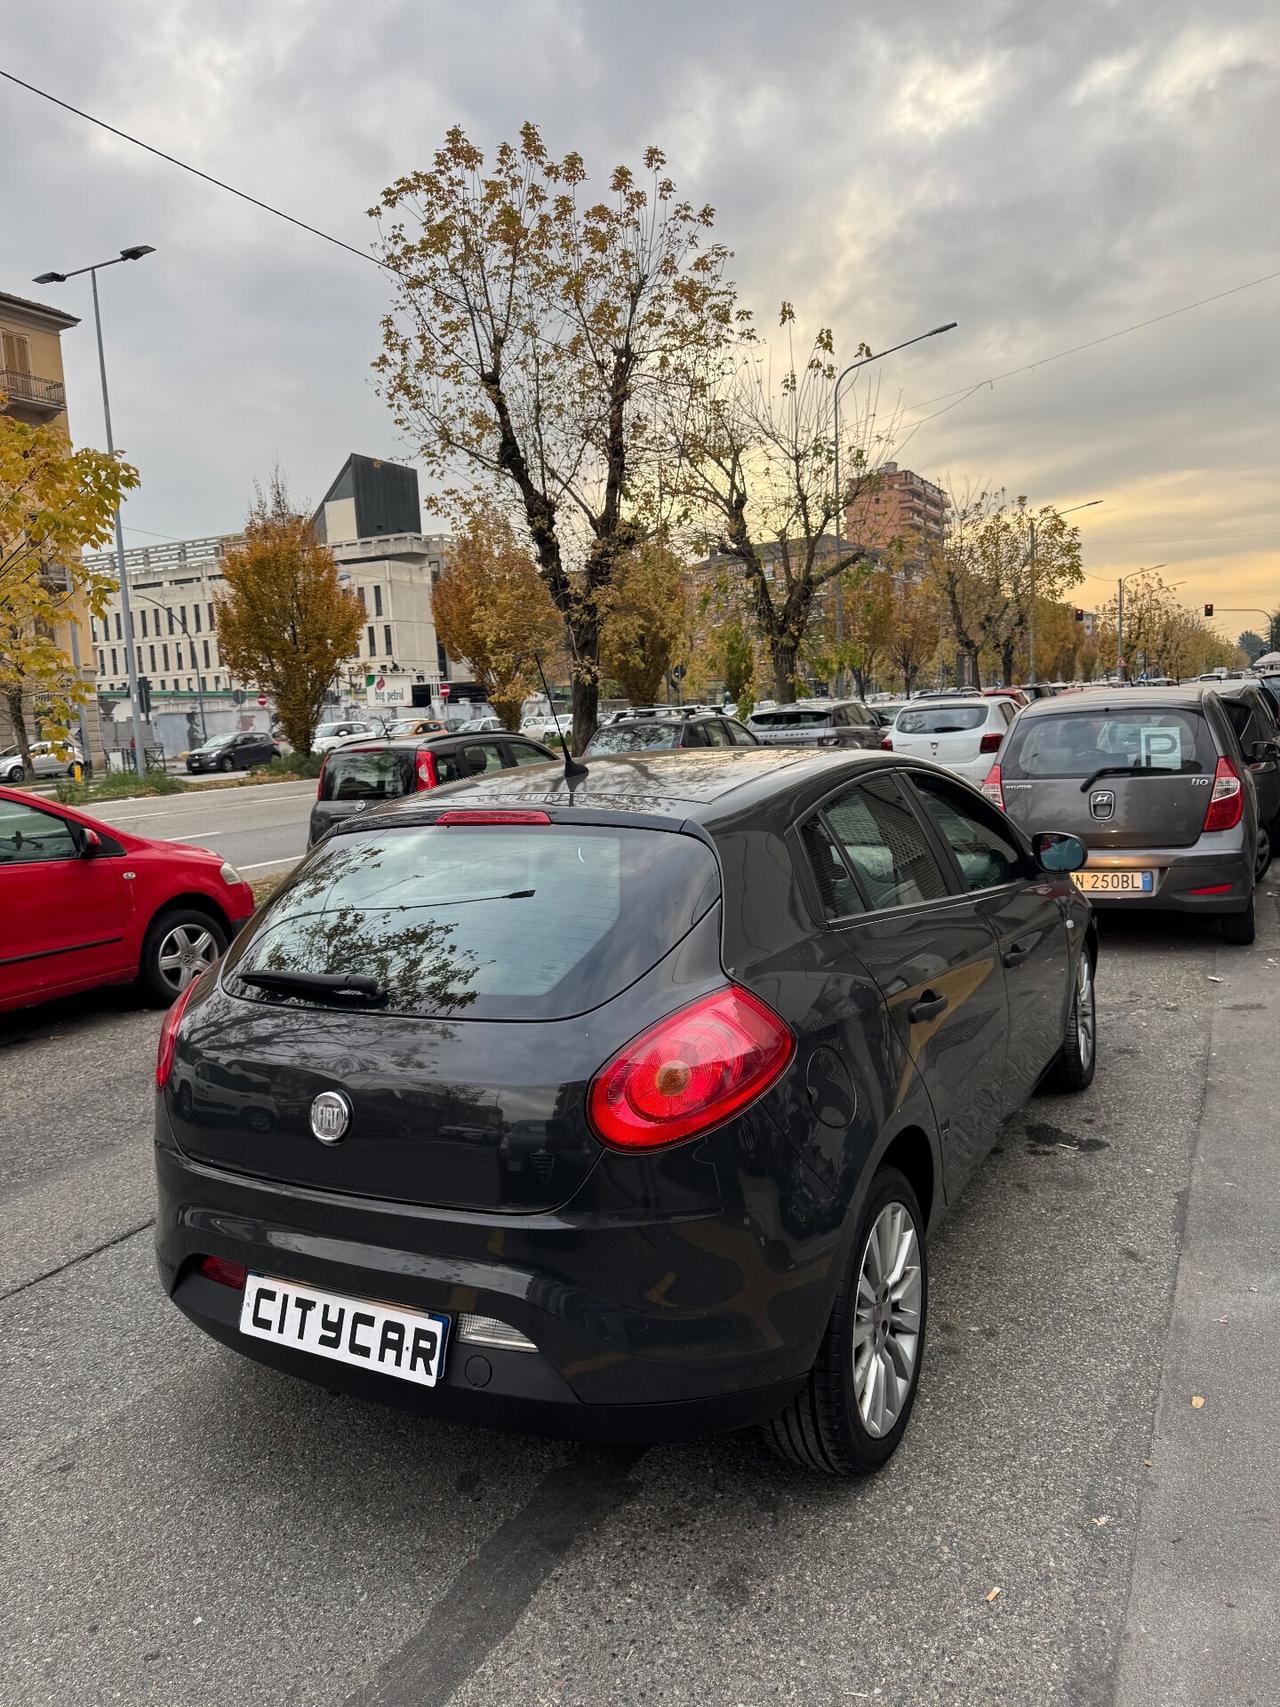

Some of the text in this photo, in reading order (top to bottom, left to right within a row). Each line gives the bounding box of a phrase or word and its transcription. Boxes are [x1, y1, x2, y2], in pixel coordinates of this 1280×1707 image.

[1145, 733, 1178, 767] P
[1071, 874, 1140, 889] N 250BL
[318, 1106, 341, 1130] FIAT
[252, 1287, 438, 1376] CITYCAR
